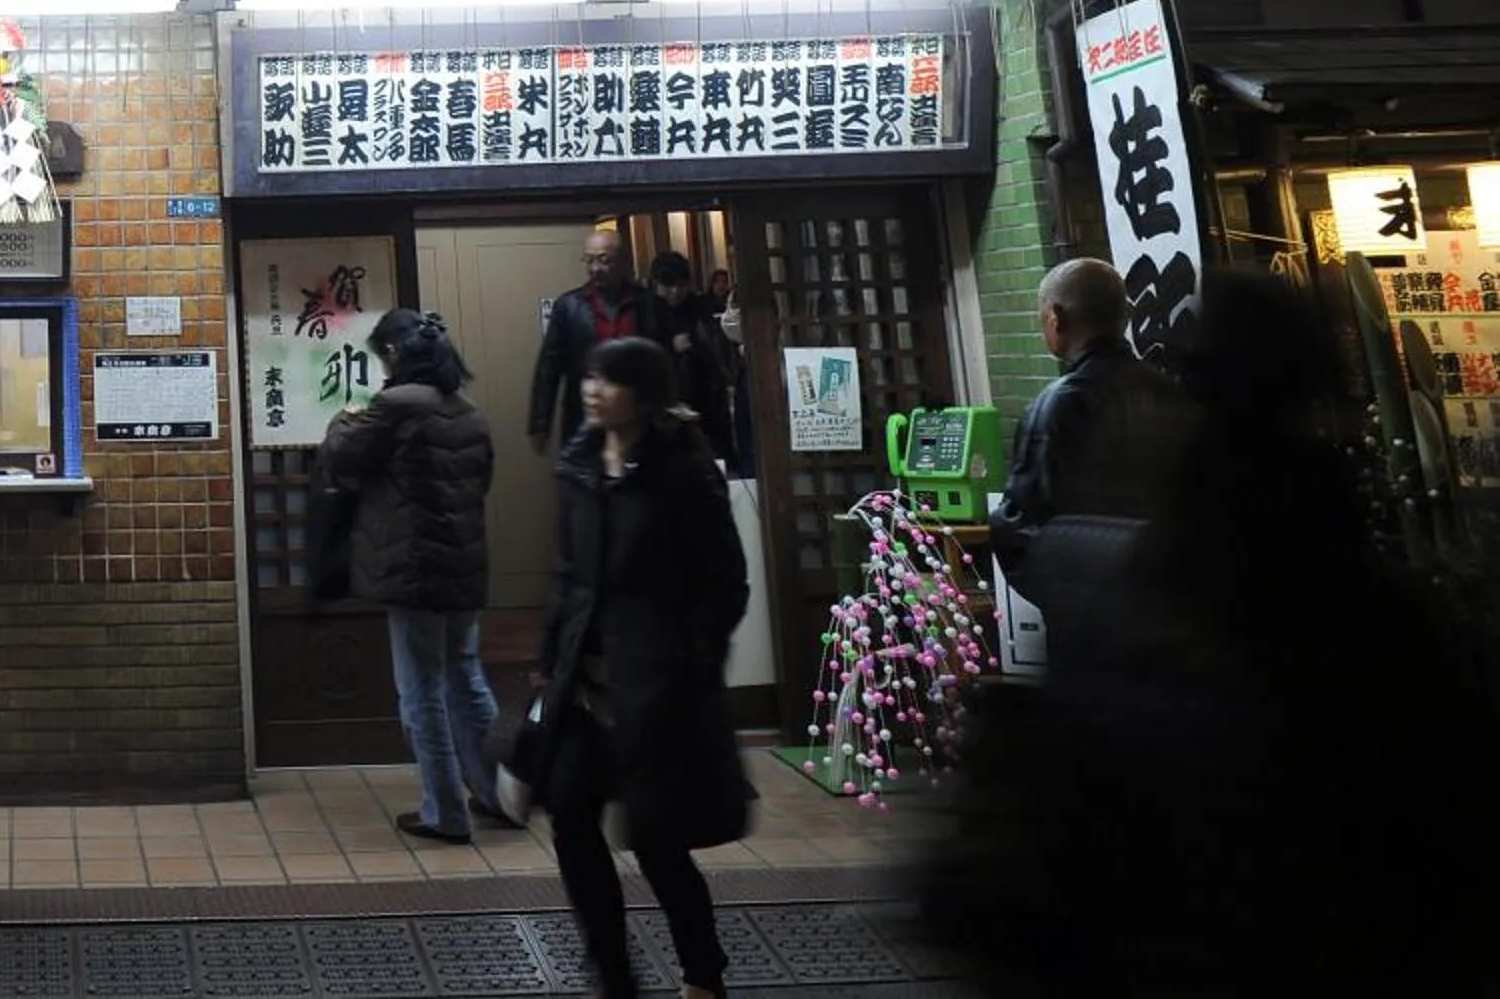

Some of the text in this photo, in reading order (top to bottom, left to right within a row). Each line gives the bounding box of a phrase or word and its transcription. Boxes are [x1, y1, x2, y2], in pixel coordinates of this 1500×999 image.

[409, 77, 442, 162] 金太郎
[516, 74, 549, 161] 米丸
[666, 71, 696, 154] 今丸
[319, 342, 369, 405] 卯
